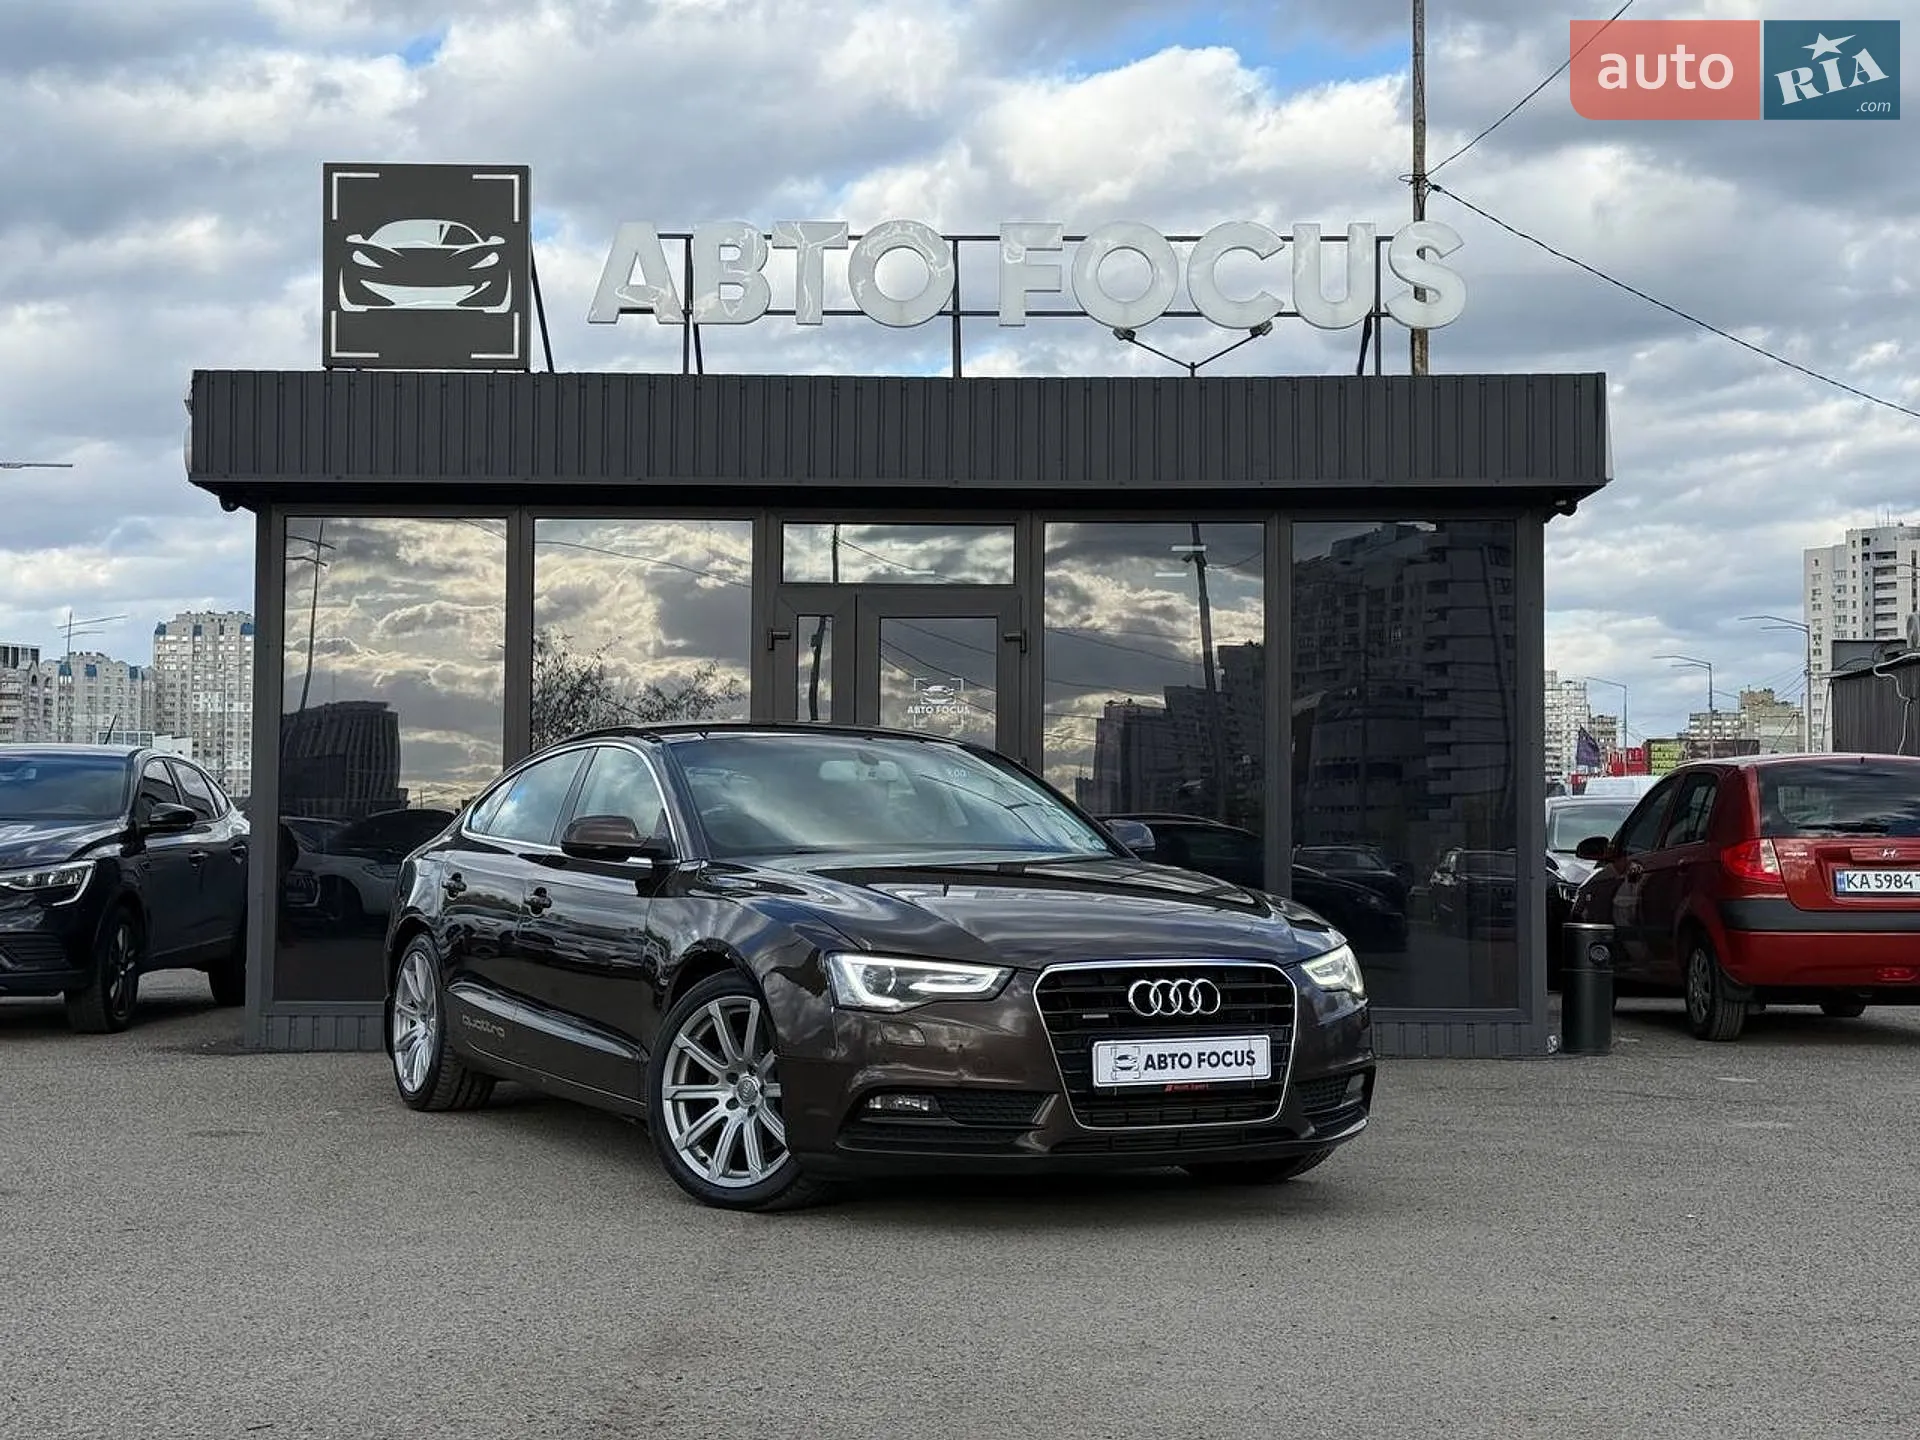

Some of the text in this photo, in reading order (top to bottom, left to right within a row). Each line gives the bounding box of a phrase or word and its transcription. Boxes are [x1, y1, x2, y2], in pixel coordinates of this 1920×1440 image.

[588, 219, 1467, 330] АВТО FOCUS
[1874, 873, 1914, 889] 5984
[1143, 1049, 1257, 1071] АВТО FOCUS
